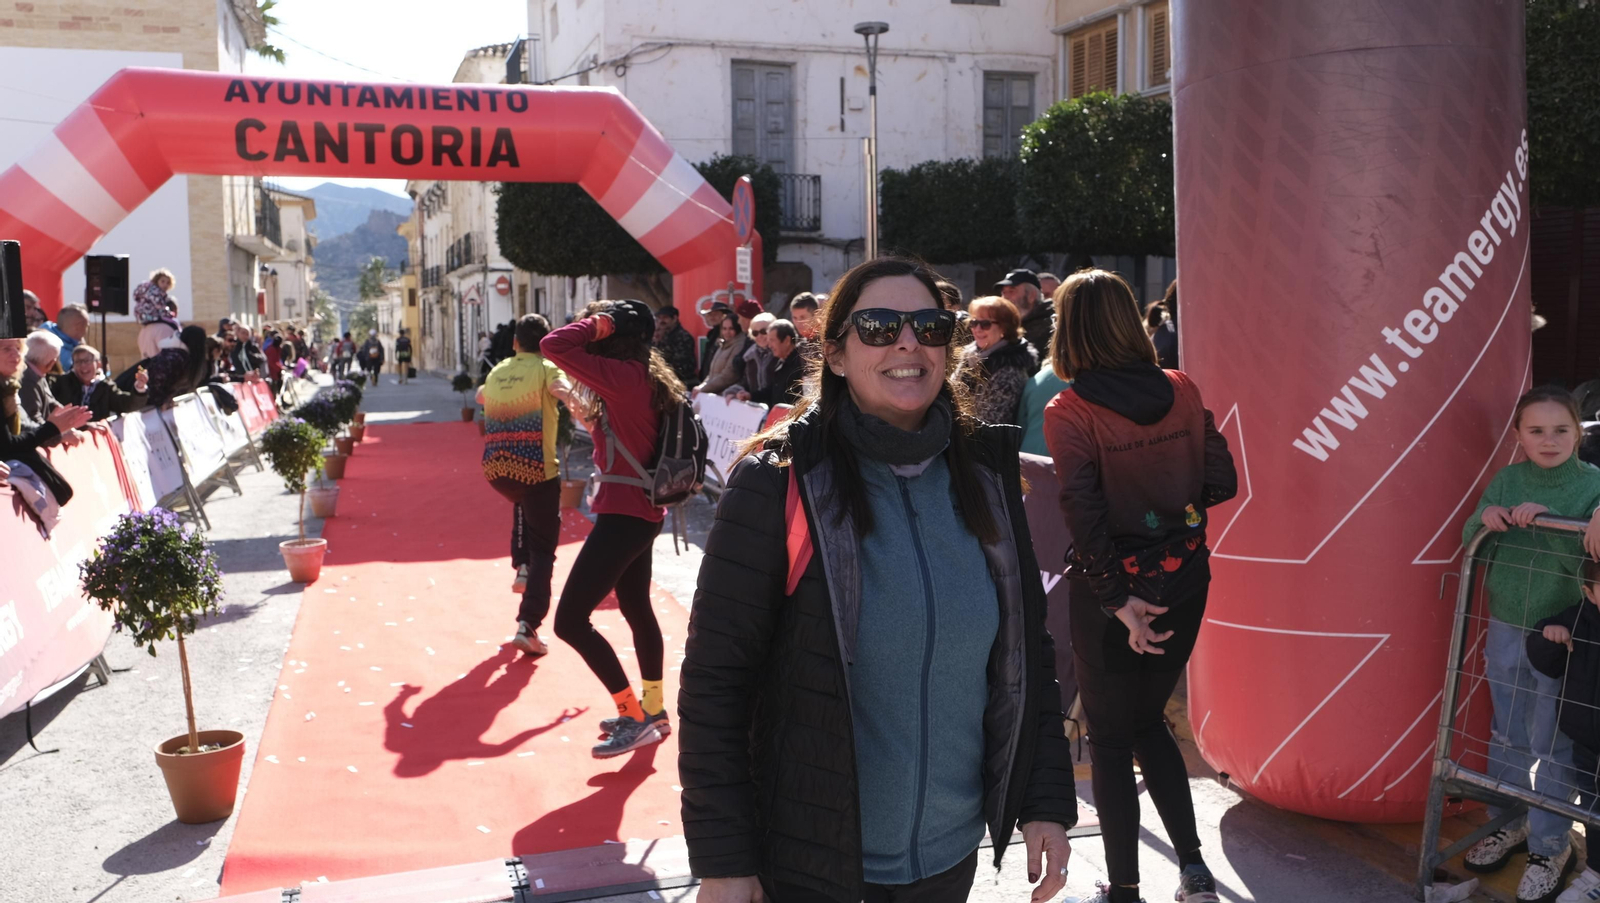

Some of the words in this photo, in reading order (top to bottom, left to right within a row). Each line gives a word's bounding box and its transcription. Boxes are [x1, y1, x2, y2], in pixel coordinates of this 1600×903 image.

[224, 79, 529, 113] AYUNTAMIENTO
[234, 118, 520, 168] CANTORIA
[1292, 128, 1528, 462] www.teamergy.es
[1106, 443, 1132, 452] VALLE
[1135, 440, 1144, 448] DE
